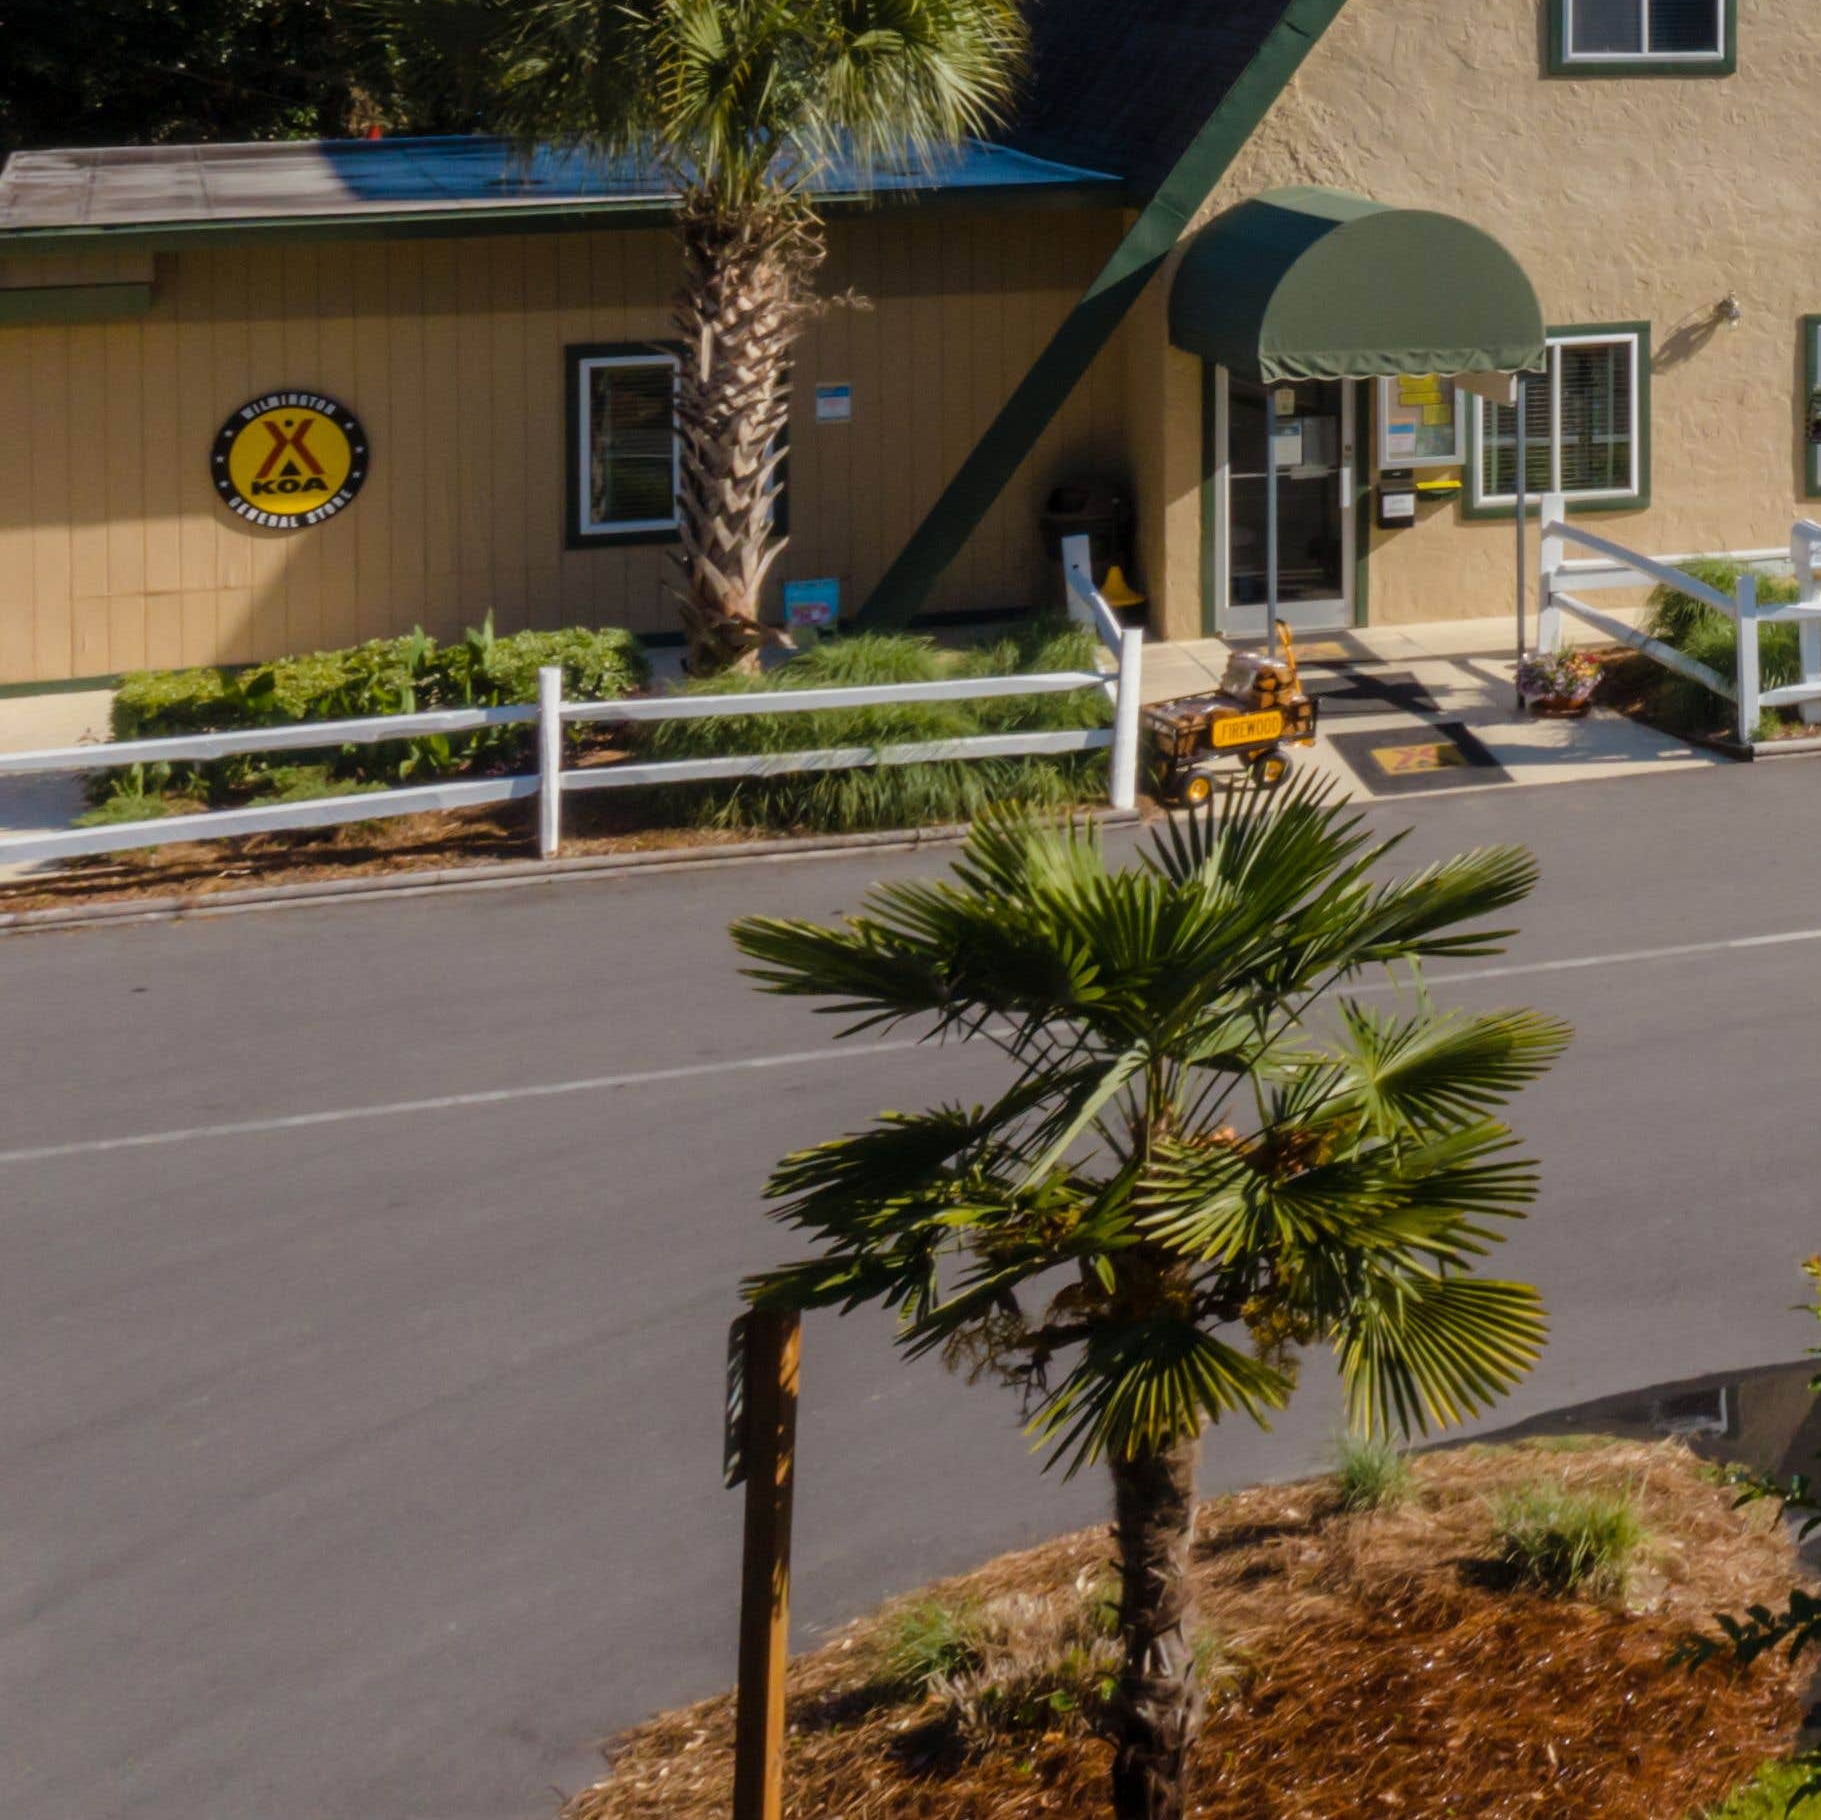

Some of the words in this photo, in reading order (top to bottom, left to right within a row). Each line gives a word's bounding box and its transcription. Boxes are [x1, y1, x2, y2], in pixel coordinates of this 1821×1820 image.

[240, 393, 337, 420] WILMINGTON
[251, 477, 329, 496] KOA
[228, 496, 299, 528] GENERAL
[305, 489, 353, 525] STORE
[1221, 714, 1280, 742] FIREWOOD
